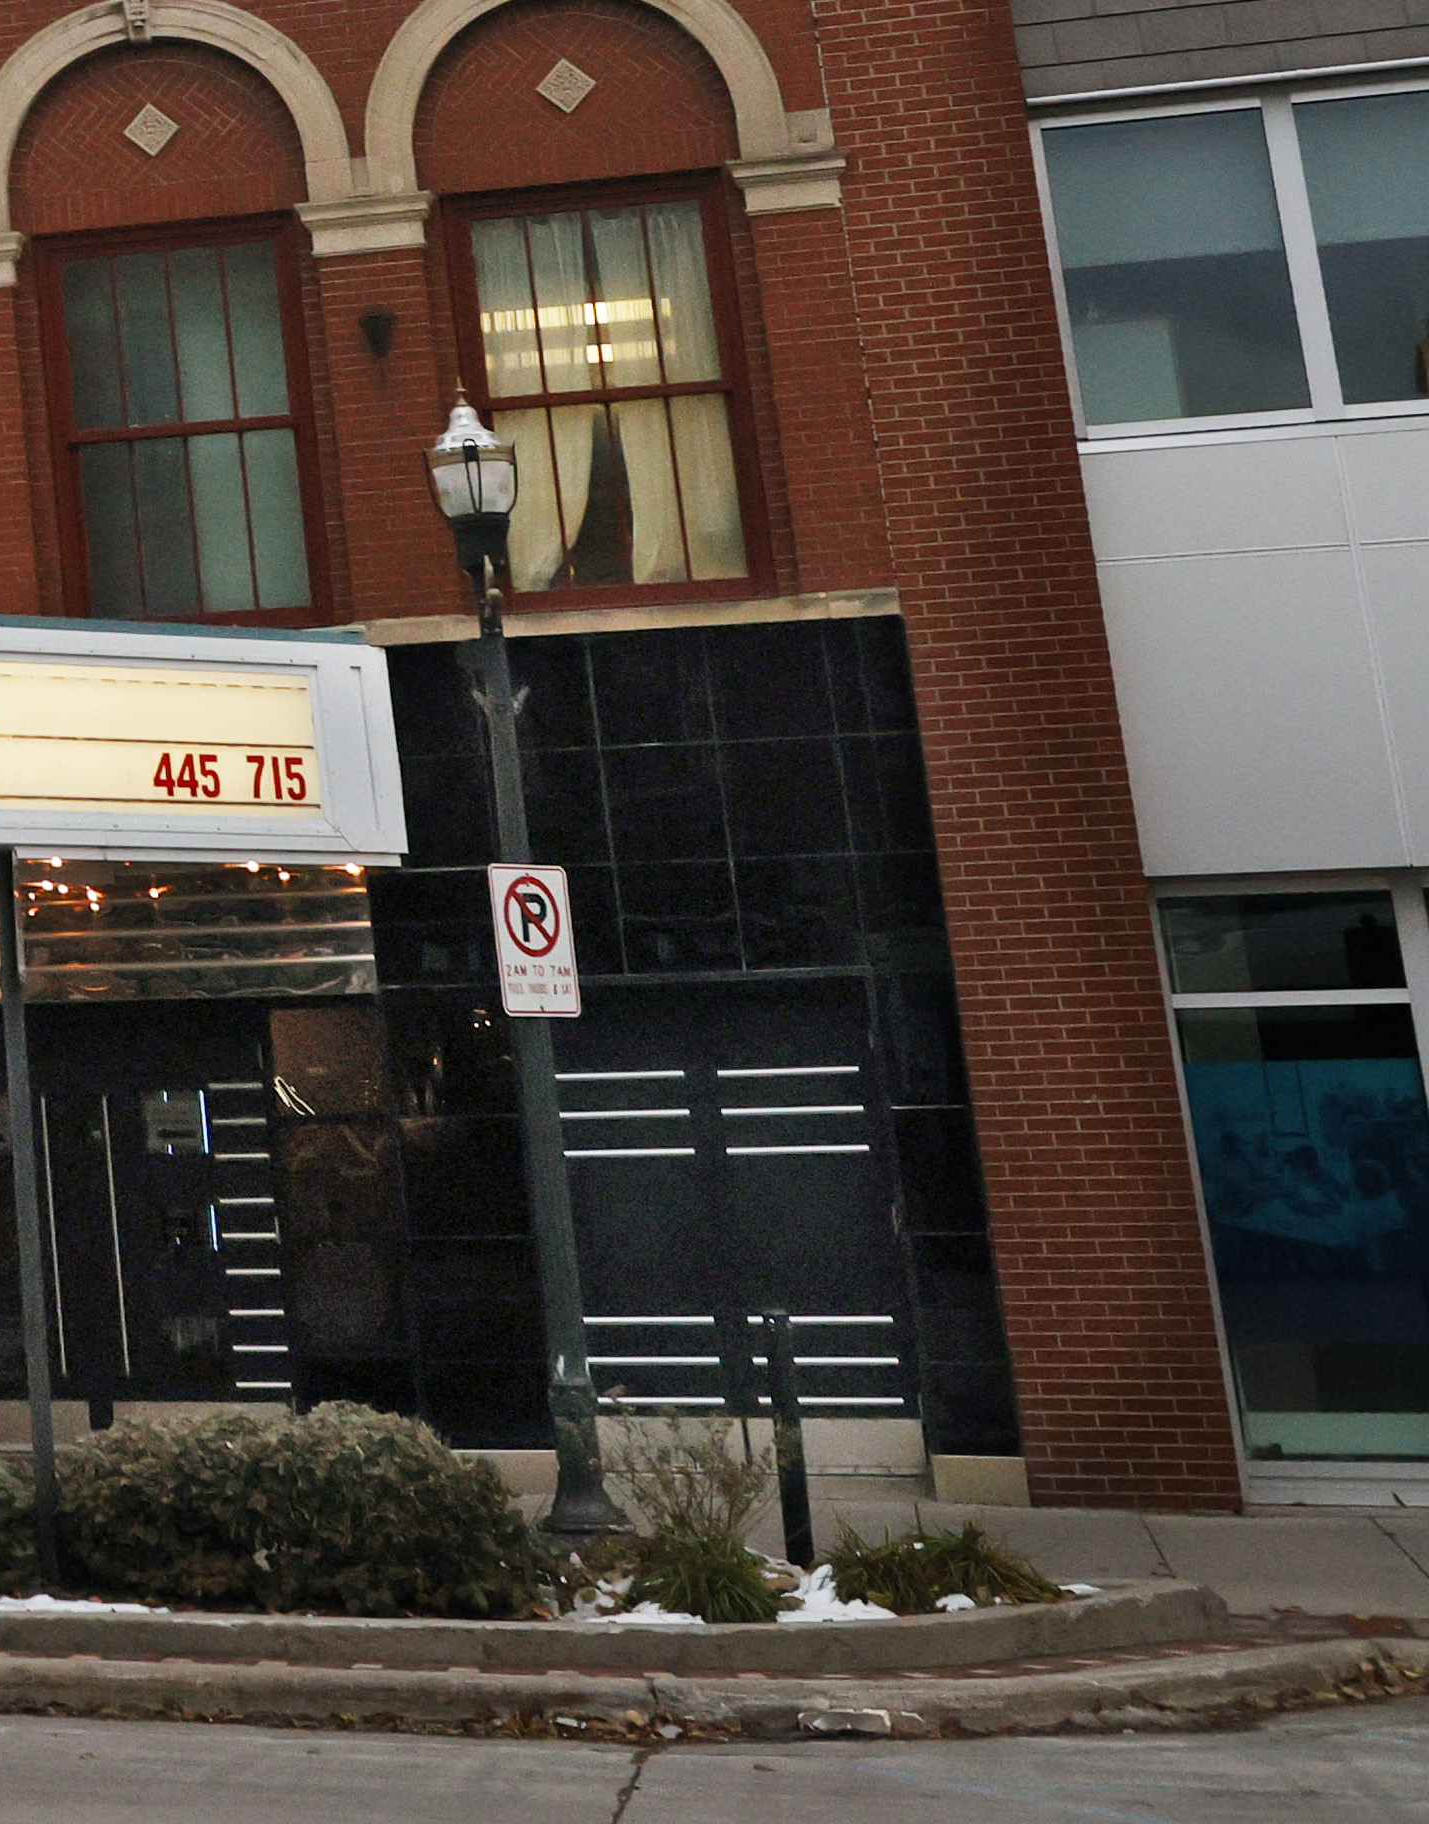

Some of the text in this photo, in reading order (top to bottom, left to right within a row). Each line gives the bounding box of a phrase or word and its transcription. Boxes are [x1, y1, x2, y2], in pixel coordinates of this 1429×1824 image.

[153, 752, 307, 801] 445 715
[505, 964, 572, 978] 2AM TO 7AM
